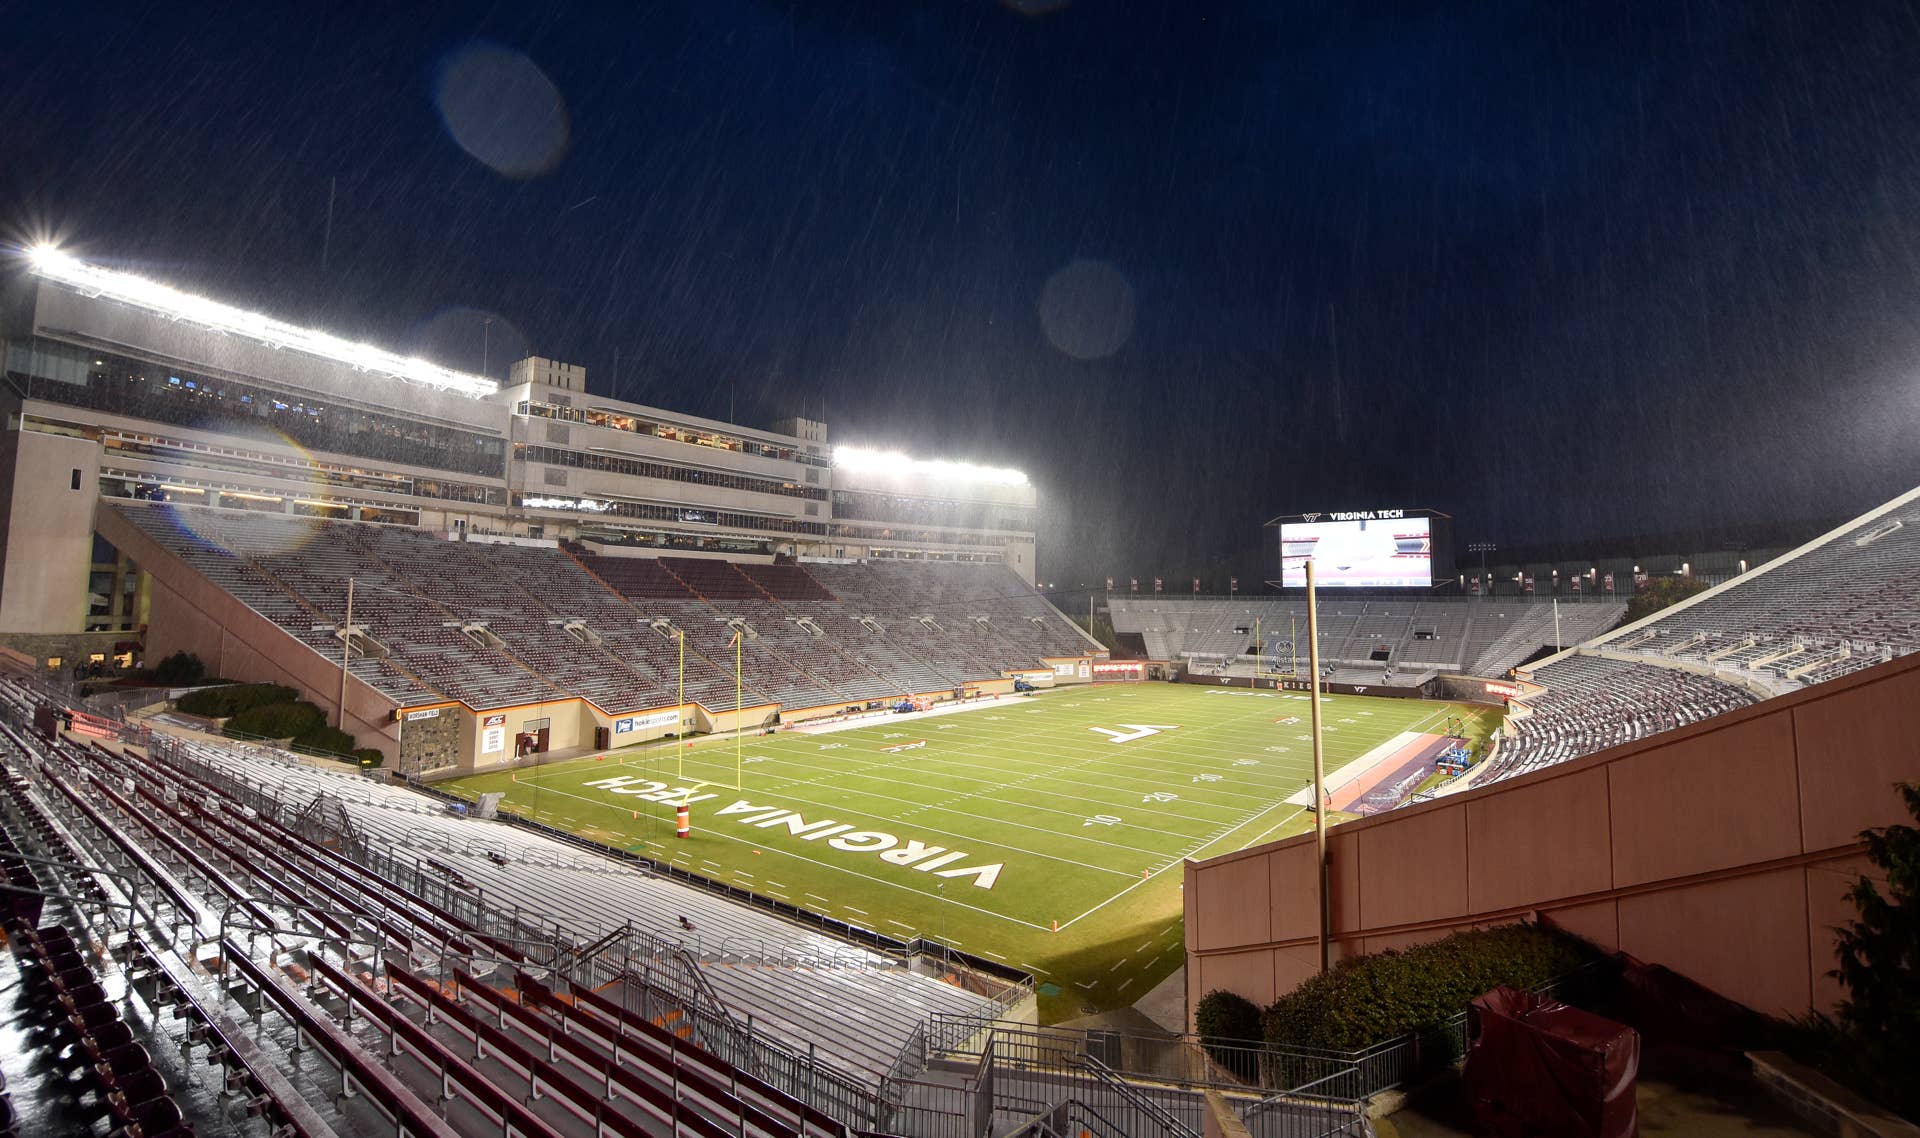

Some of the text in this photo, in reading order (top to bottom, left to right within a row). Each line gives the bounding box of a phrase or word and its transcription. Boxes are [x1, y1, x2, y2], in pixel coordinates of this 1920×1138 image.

[1302, 509, 1404, 523] VT VIRGINIA TECH
[1271, 655, 1301, 665] Allstae
[1269, 681, 1312, 690] HKIES
[1354, 686, 1367, 694] VT
[582, 775, 1006, 890] VIRGINIA TECH
